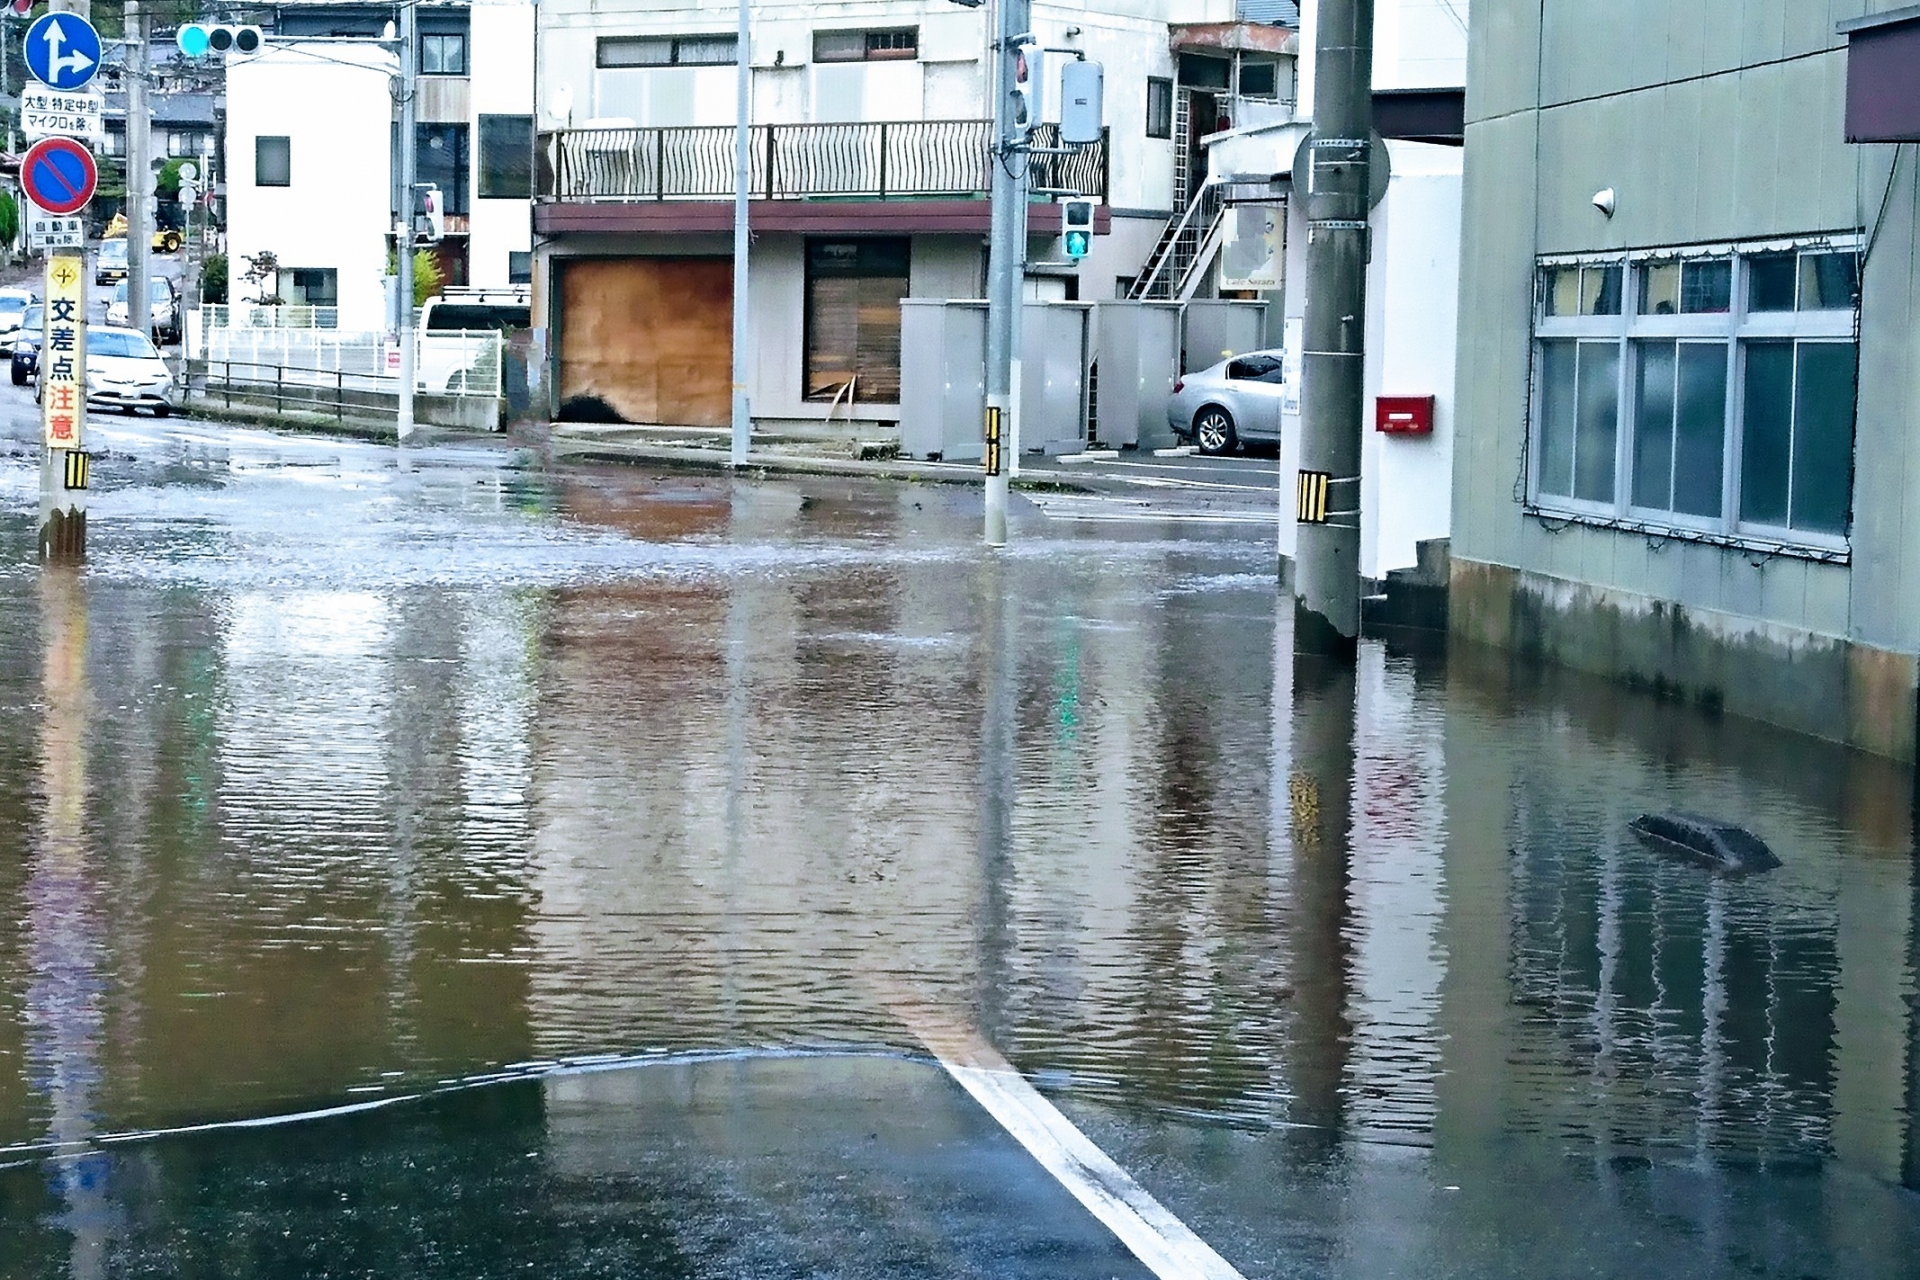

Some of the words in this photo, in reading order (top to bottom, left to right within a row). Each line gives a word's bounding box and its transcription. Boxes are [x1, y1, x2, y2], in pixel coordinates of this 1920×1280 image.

[28, 115, 92, 131] マイクロを除く
[36, 220, 78, 232] 自動車
[49, 297, 75, 440] 交差点注意
